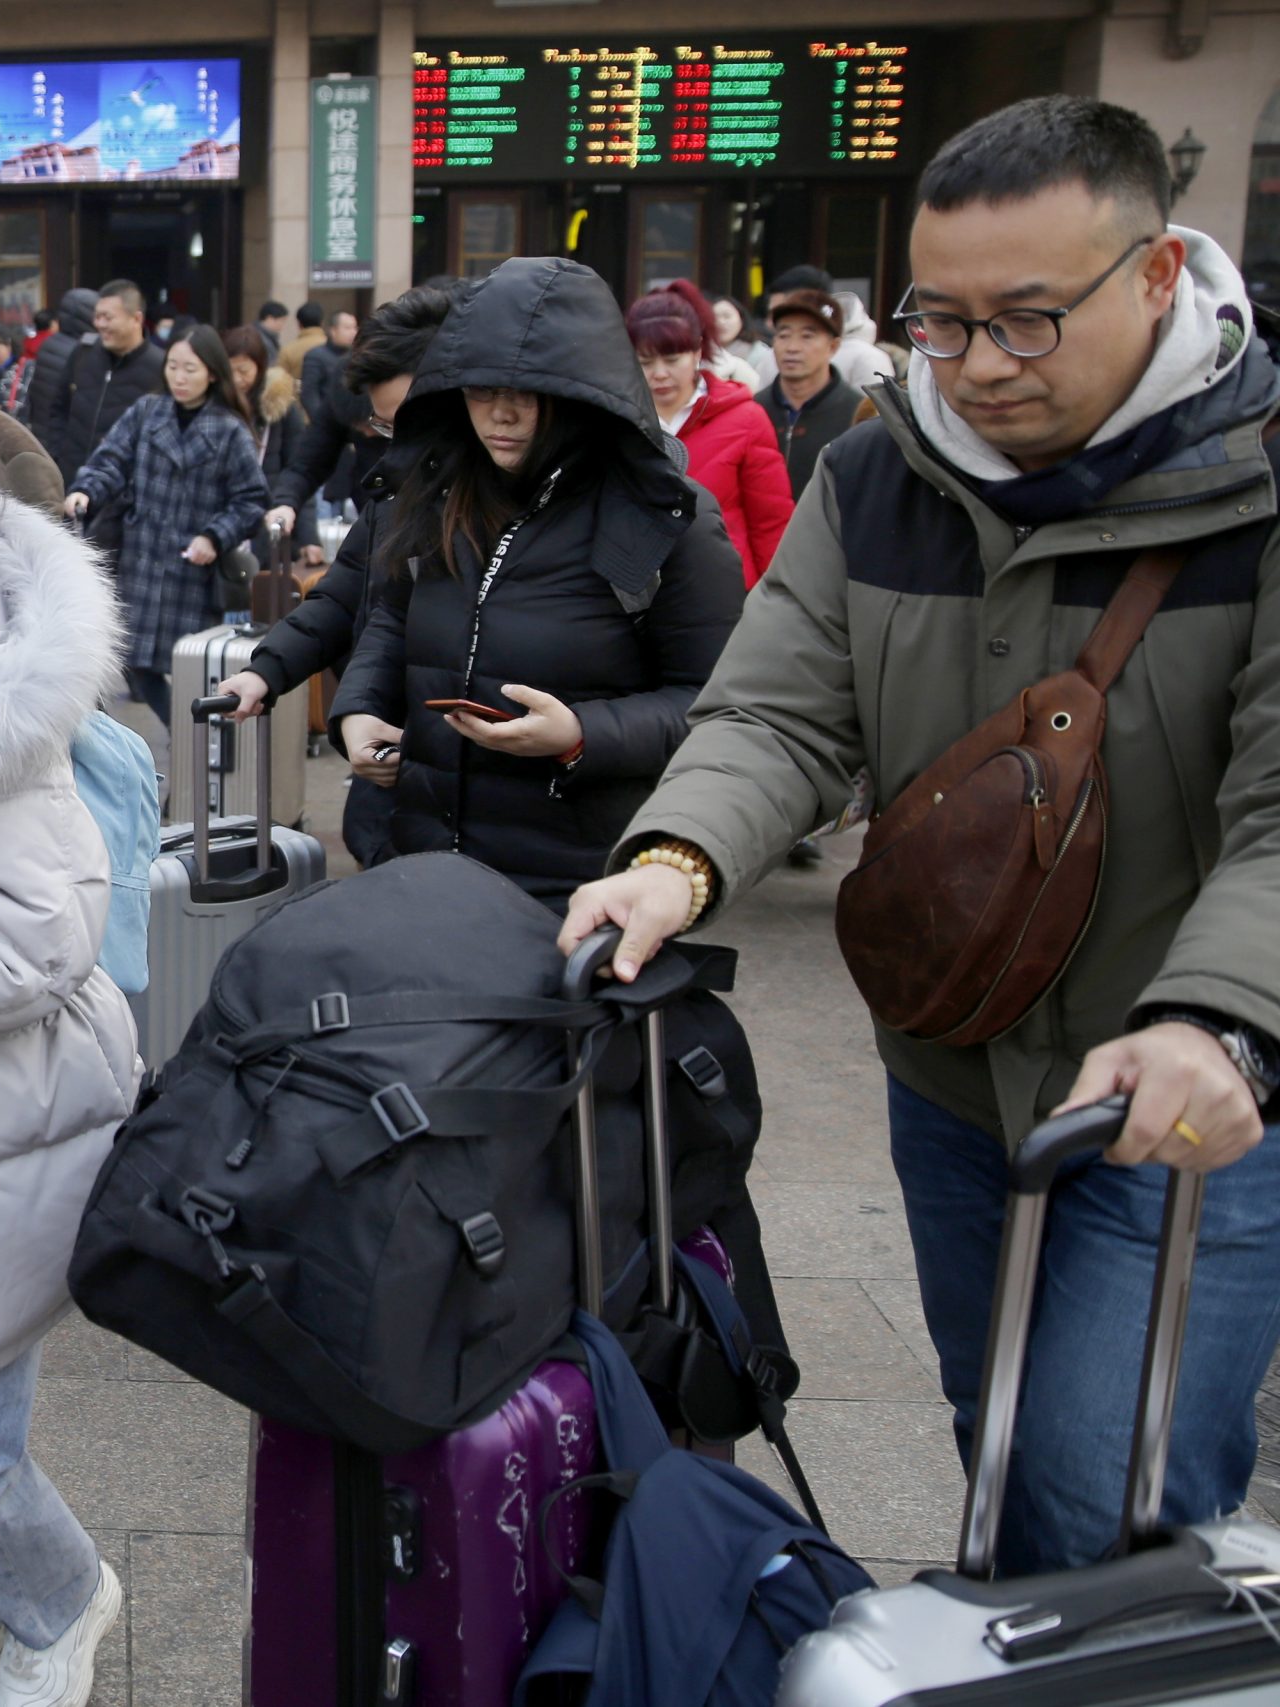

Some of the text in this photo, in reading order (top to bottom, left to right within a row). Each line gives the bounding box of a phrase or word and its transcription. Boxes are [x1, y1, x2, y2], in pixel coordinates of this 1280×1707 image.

[327, 108, 359, 261] 悦途商务休息室
